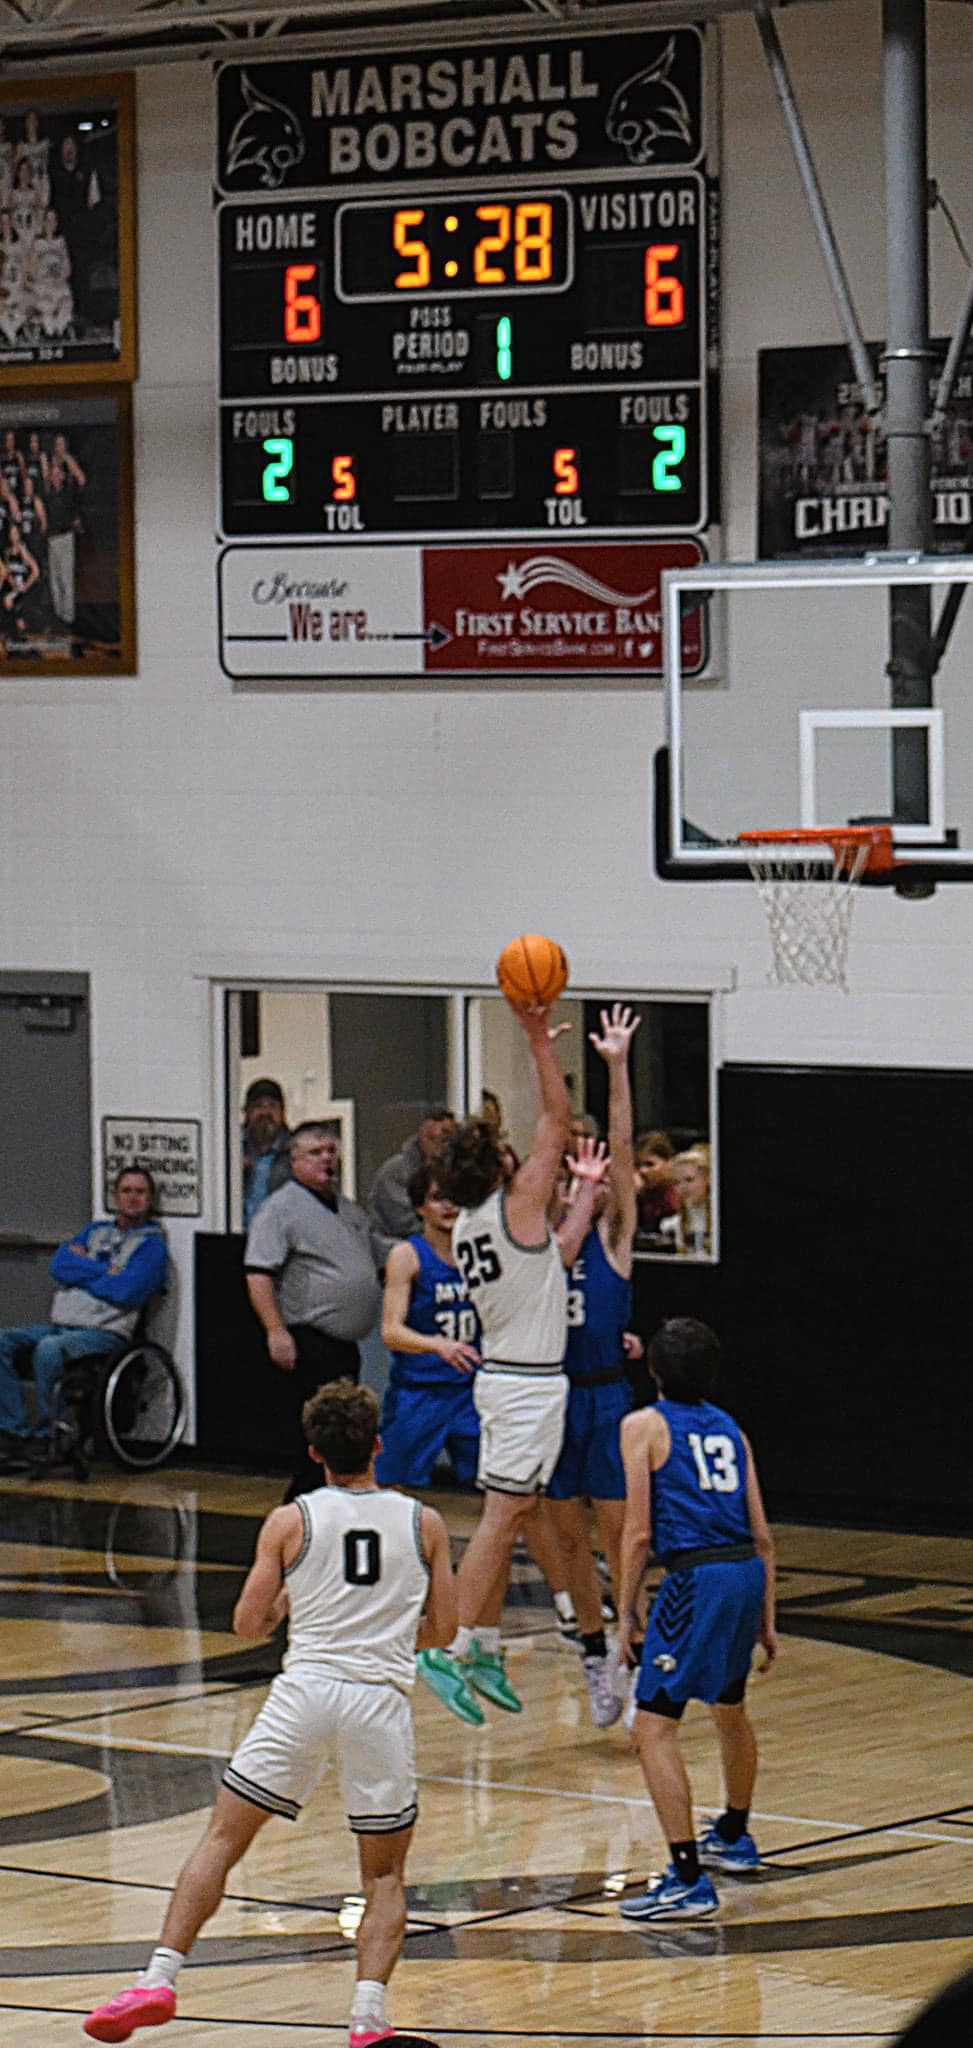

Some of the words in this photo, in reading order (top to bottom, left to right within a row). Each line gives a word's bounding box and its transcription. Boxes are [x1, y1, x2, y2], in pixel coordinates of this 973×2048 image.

[311, 50, 599, 118] MARSHALL
[329, 110, 580, 174] BOBCATS
[580, 190, 696, 232] VISITOR
[235, 213, 316, 251] HOME
[393, 203, 552, 288] 5:28
[284, 263, 321, 343] 6
[645, 244, 684, 327] 6
[392, 330, 468, 360] PERIOD
[496, 316, 511, 380] 1
[570, 342, 644, 371] BONUS
[270, 354, 338, 385] BONUS
[232, 409, 296, 439] FOULS
[382, 403, 460, 432] PLAYER
[479, 400, 547, 429] FOULS
[619, 394, 690, 425] FOULS
[262, 438, 294, 503] 2
[331, 455, 356, 501] 5
[552, 448, 580, 495] 5
[652, 425, 687, 492] 2
[324, 505, 365, 532] TOL
[545, 499, 588, 527] TOL
[252, 573, 348, 605] Because
[289, 602, 323, 642] We
[455, 608, 515, 637] FIRST
[519, 606, 610, 636] SERVICE
[112, 1134, 133, 1150] NO
[457, 1233, 502, 1289] 25
[434, 1310, 477, 1344] 30
[687, 1433, 740, 1493] 13
[343, 1528, 381, 1587] 0
